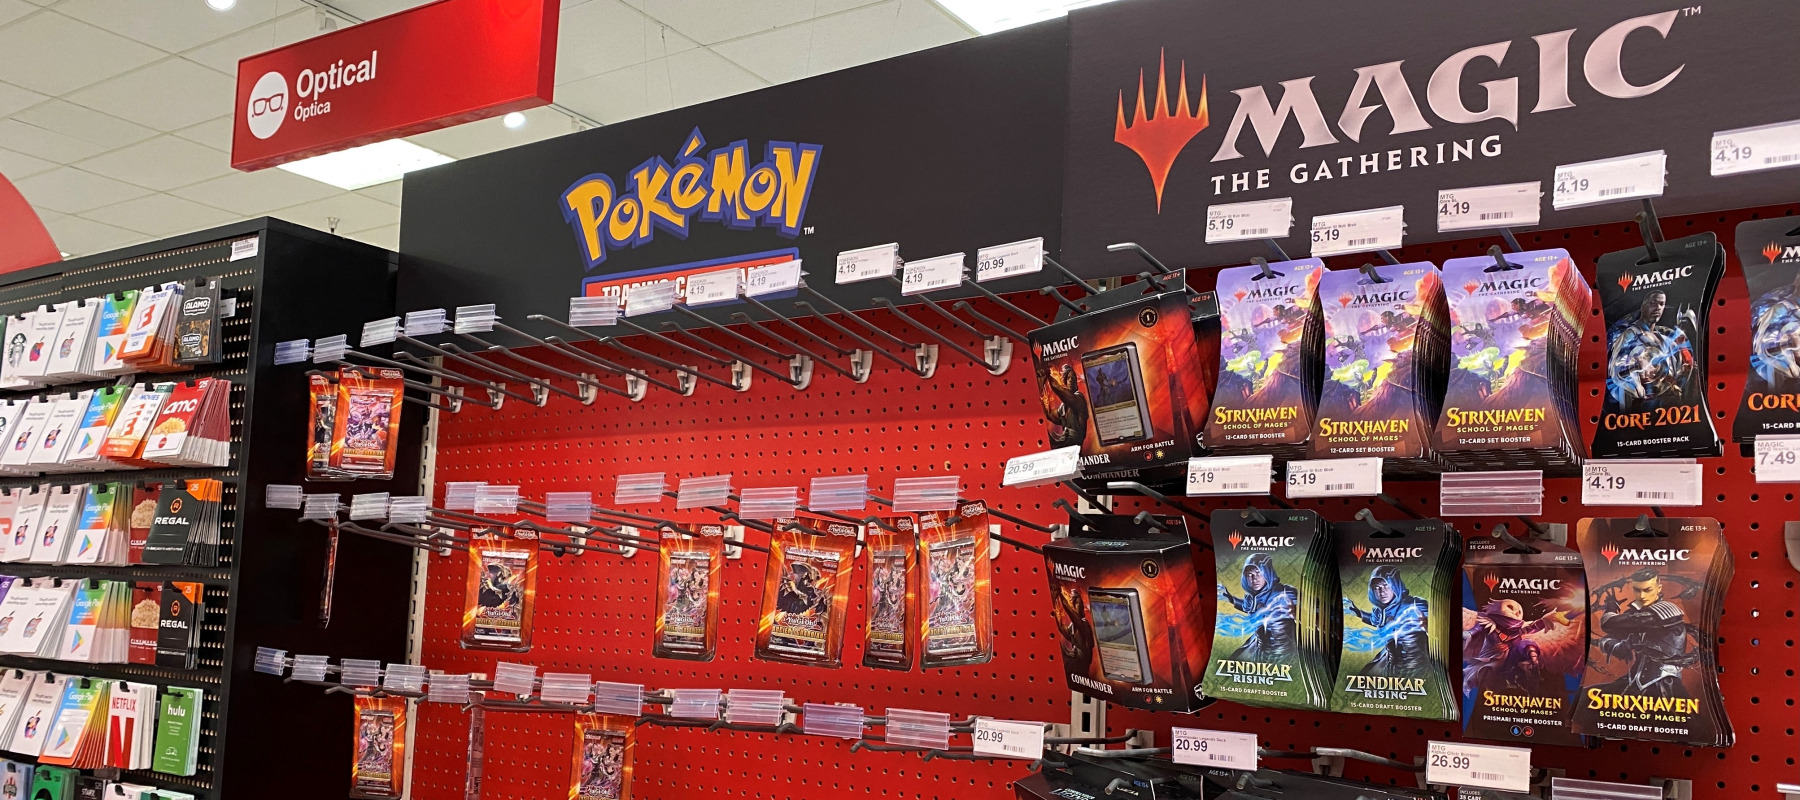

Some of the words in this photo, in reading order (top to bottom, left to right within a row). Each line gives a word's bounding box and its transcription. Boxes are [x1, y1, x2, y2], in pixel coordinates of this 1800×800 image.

[296, 50, 377, 100] Optical
[1210, 10, 1685, 162] MAGIC
[294, 101, 331, 121] Óptica
[1715, 146, 1752, 162] 4.19
[1211, 173, 1270, 195] THE
[1290, 134, 1503, 184] GATHERING
[1556, 179, 1589, 193] 4.19
[1440, 202, 1470, 215] 4.19
[804, 226, 815, 236] TM
[1208, 218, 1234, 231] 5.19
[1312, 229, 1340, 242] 5.19
[838, 264, 856, 274] 4.19
[978, 258, 1004, 272] 20.99
[750, 276, 766, 287] 4.19
[904, 273, 923, 284] 4.19
[1632, 265, 1694, 287] MAGIC
[690, 286, 705, 295] 4.19
[1479, 278, 1542, 292] MAGIC
[1247, 285, 1299, 299] MAGIC
[1353, 290, 1409, 305] MAGIC
[185, 300, 209, 310] ALAMO
[103, 311, 119, 320] Google
[1043, 335, 1079, 357] MAGIC
[163, 398, 197, 414] amc
[1748, 393, 1800, 412] COR
[1214, 406, 1298, 424] STRIXHAVEN
[1446, 407, 1546, 427] STRIXHAVEN
[1604, 412, 1652, 430] CORE
[1655, 404, 1701, 426] 2021
[1319, 417, 1409, 437] STRIXHAVEN
[1131, 445, 1143, 453] ARM
[1143, 443, 1154, 451] FOR
[1154, 440, 1175, 449] BATTLE
[1617, 439, 1642, 447] 15-CARD
[1643, 437, 1671, 445] BOOSTER
[1078, 453, 1111, 468] MANDER
[1758, 451, 1796, 465] 7.49
[1008, 462, 1034, 475] 20.99
[1189, 472, 1214, 484] 5.19
[1289, 473, 1316, 485] 5.19
[85, 504, 101, 513] Google
[154, 517, 189, 525] REGAL
[1241, 536, 1295, 547] MAGIC
[1366, 547, 1423, 558] MAGIC
[1619, 548, 1690, 561] MAGIC
[1055, 562, 1086, 580] MAGIC
[1499, 578, 1562, 590] MAGIC
[75, 598, 91, 608] Google
[160, 620, 188, 629] REGAL
[1215, 660, 1293, 679] ZENDIKAR
[1071, 673, 1114, 695] COMMANDER
[1233, 675, 1274, 685] RISING
[1345, 675, 1427, 693] ZENDIKAR
[69, 692, 84, 702] Google
[1243, 687, 1262, 695] DRAFT
[1262, 689, 1288, 697] BOOSTER
[1364, 690, 1408, 700] RISING
[112, 697, 136, 713] NETFLIX
[1483, 691, 1562, 709] STRIXHAVEN
[1587, 688, 1700, 714] STRIXHAVEN
[168, 704, 186, 717] hulu
[1599, 711, 1637, 720] SCHOOL
[1654, 714, 1687, 723] MAGES
[1483, 715, 1512, 723] PRISMARI
[1533, 718, 1562, 726] BOOSTER
[1597, 723, 1627, 731] 15-CARD
[1628, 725, 1653, 733] DRAFT
[1654, 726, 1689, 735] BOOSTER
[977, 729, 1003, 743] 20.99
[1175, 739, 1208, 752] 20.99
[1431, 754, 1470, 769] 26.99
